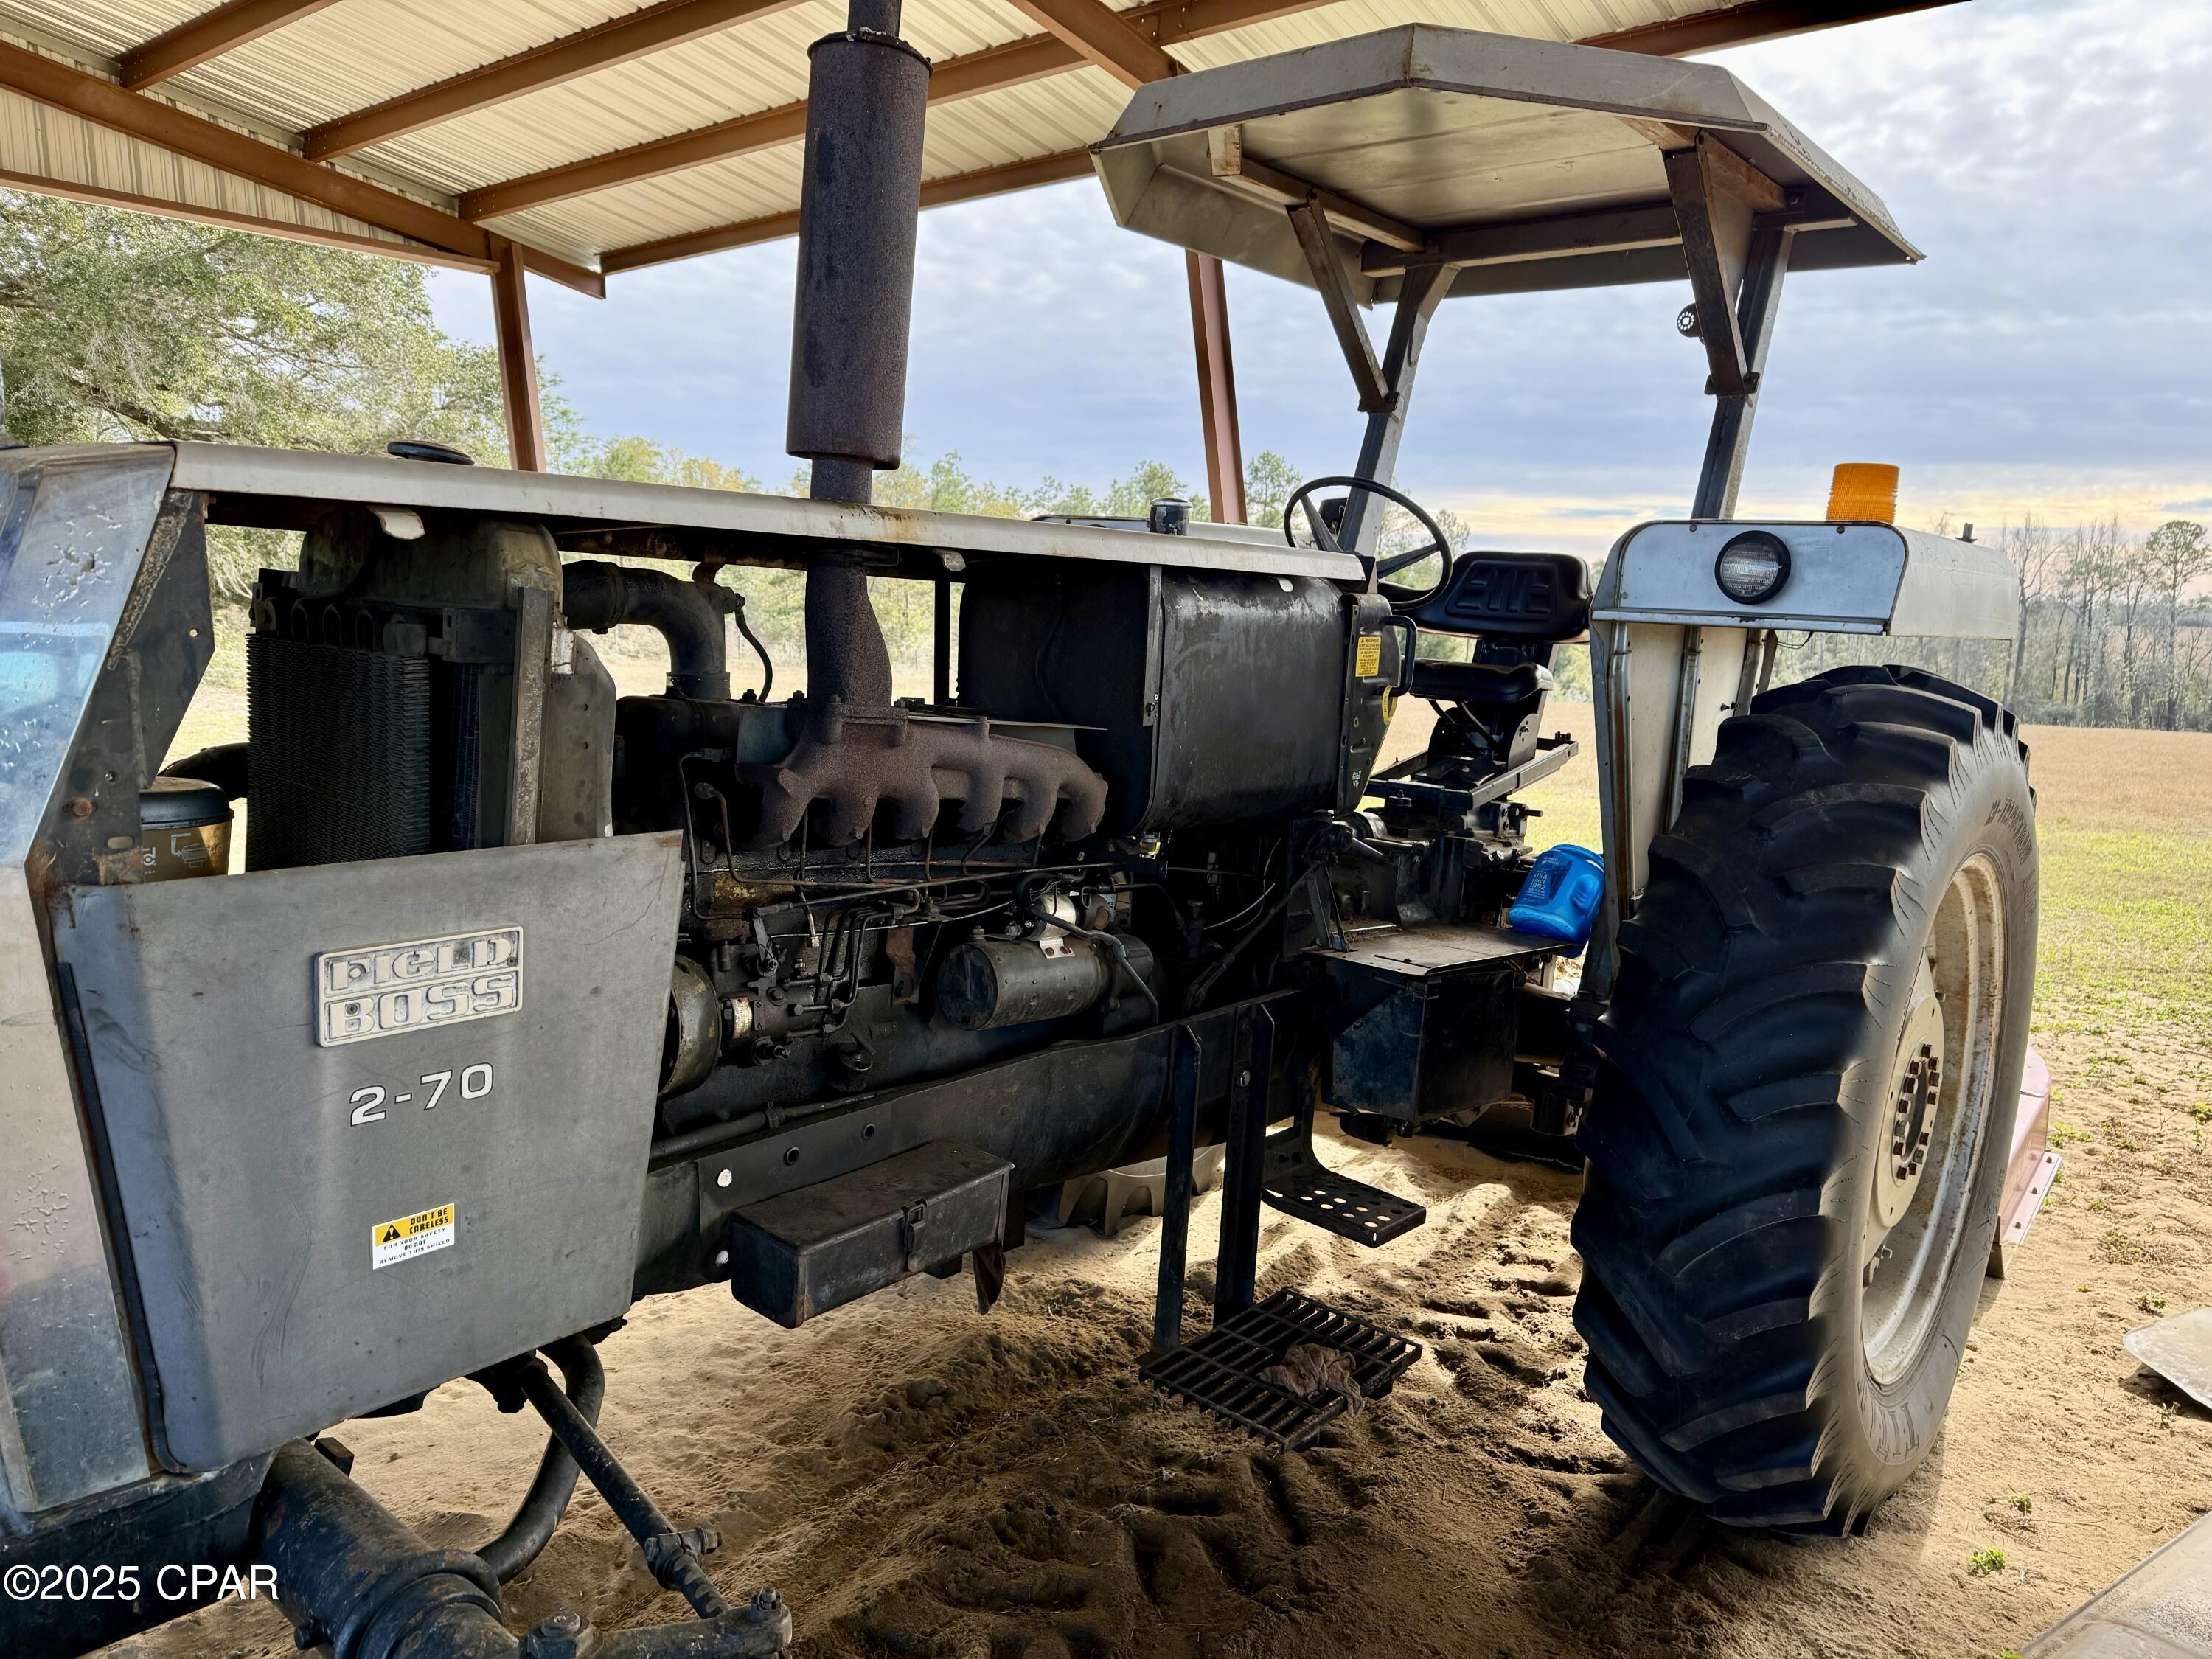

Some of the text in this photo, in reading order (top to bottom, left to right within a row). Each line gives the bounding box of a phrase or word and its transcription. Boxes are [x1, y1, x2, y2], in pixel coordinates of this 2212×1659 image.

[1534, 872, 1548, 880] USA
[1529, 883, 1547, 891] 1892
[329, 973, 515, 1039] BOSS
[349, 1062, 494, 1127] 2-70
[409, 1216, 449, 1234] CARELESS
[410, 1207, 448, 1225] DON'T BE
[383, 1227, 446, 1251] FOR YOUR SAFETY
[414, 1239, 426, 1248] NOT
[379, 1238, 450, 1265] REMOVE THIS SHIELD
